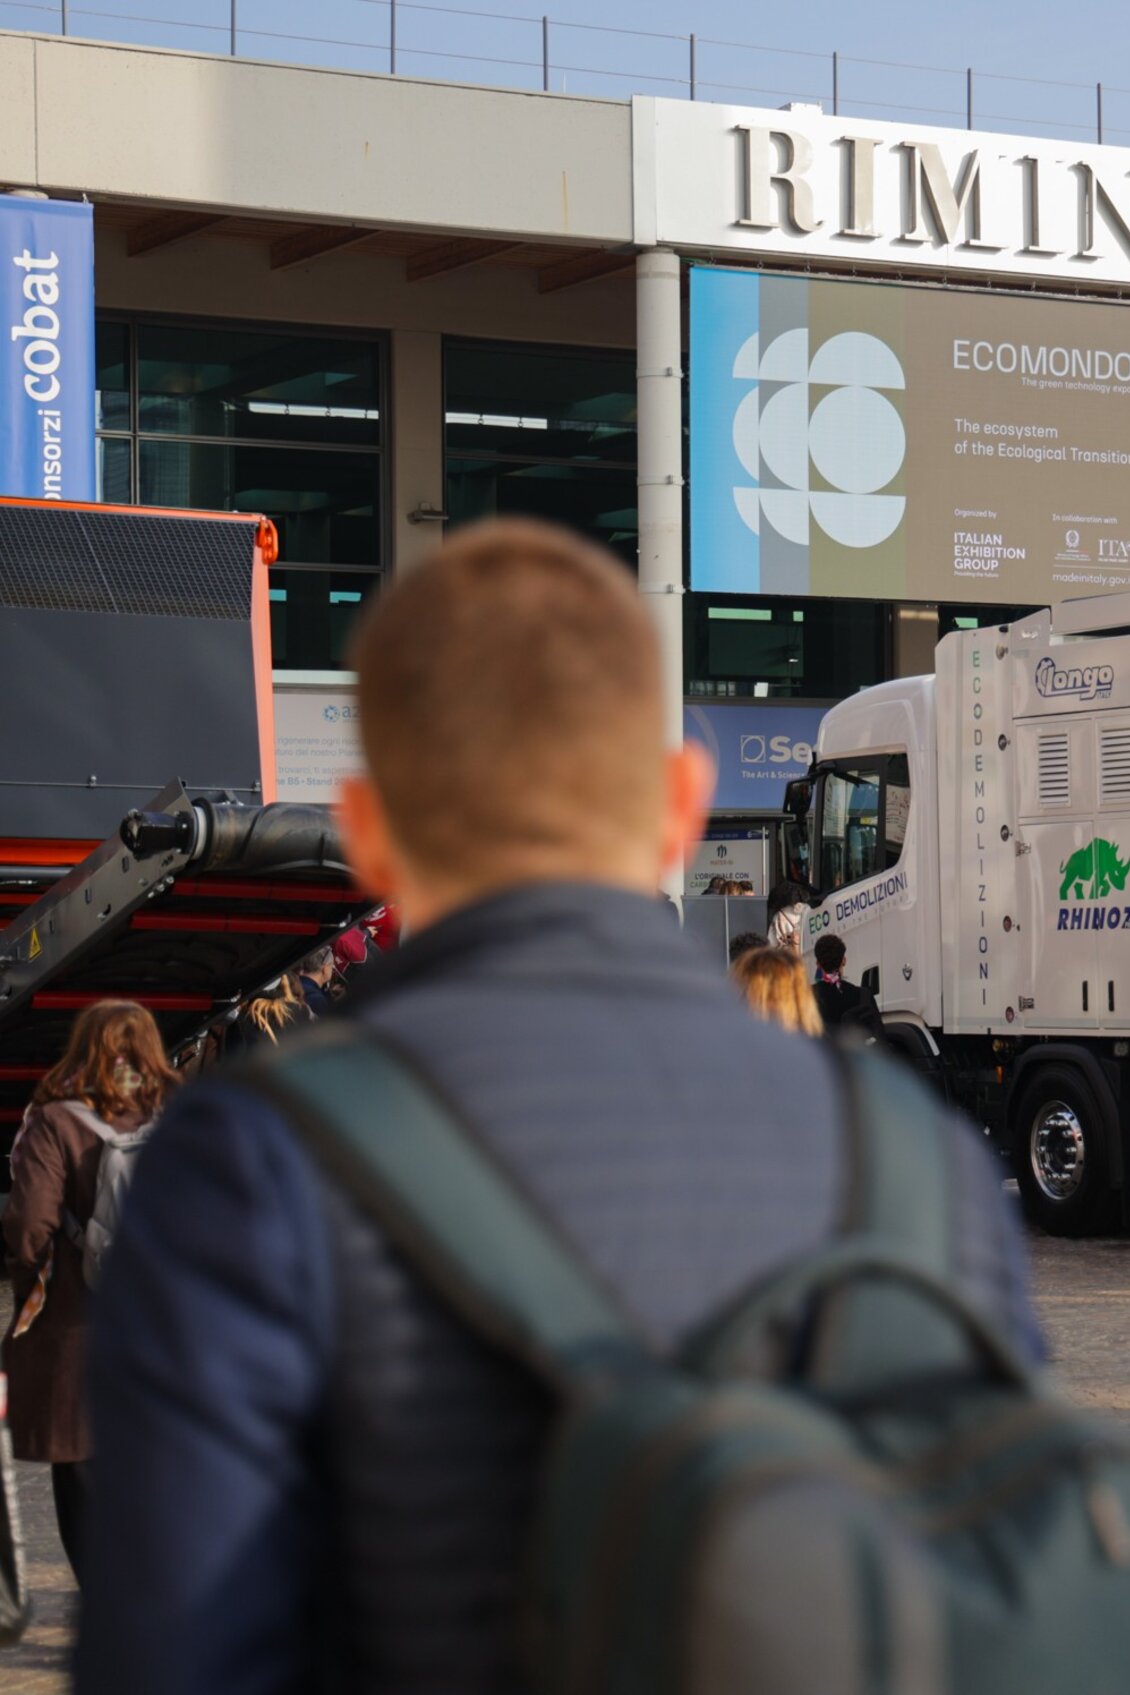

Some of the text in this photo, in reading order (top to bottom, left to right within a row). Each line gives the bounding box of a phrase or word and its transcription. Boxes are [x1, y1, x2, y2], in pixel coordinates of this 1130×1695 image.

[11, 249, 60, 403] cobat
[1021, 376, 1037, 387] The
[1038, 379, 1063, 390] green
[1064, 381, 1111, 394] technology
[954, 418, 1058, 440] The ecosystem
[954, 440, 968, 454] of
[972, 441, 994, 457] the
[998, 443, 1067, 463] Ecological
[988, 510, 997, 519] by
[1103, 516, 1118, 524] with
[954, 532, 1002, 545] ITALIAN
[954, 545, 1026, 560] EXHIBITION
[1098, 539, 1128, 557] ITA
[954, 558, 999, 571] GROUP
[808, 910, 830, 935] ECO
[836, 871, 908, 921] DEMOLIZIONI
